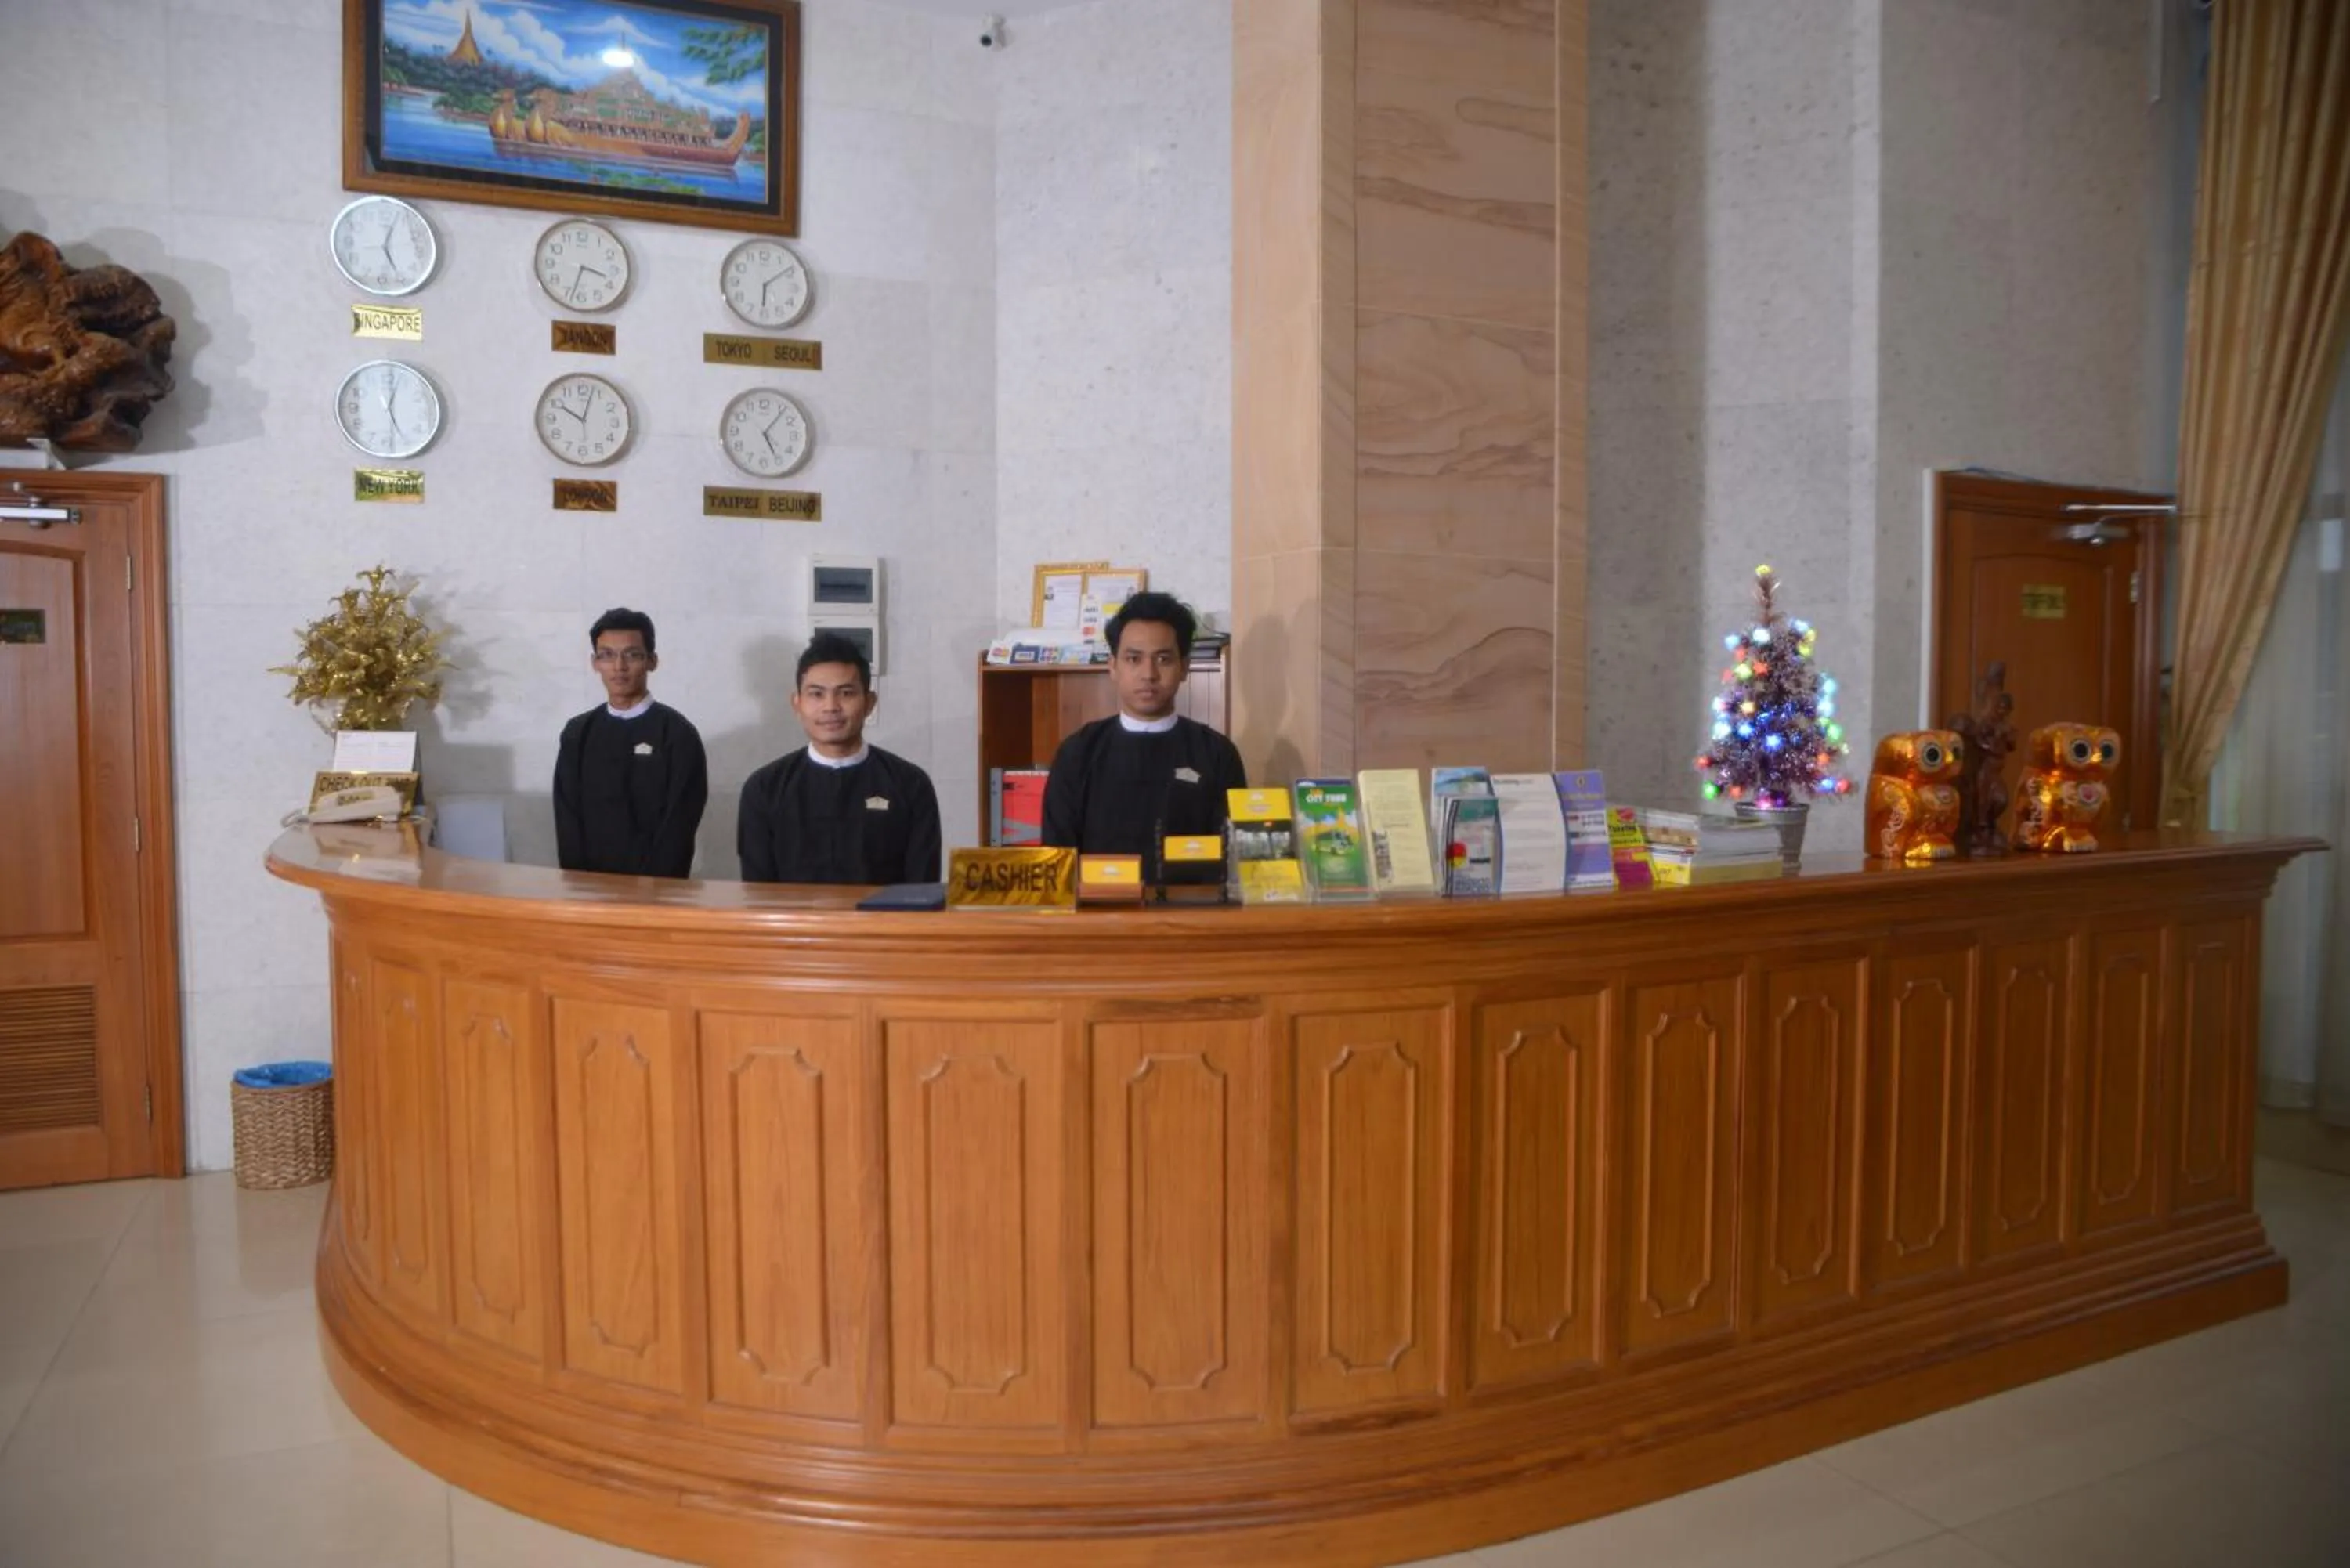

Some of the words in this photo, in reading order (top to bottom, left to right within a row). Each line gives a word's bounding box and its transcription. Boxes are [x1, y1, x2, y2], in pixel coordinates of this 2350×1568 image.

[354, 313, 421, 333] INGAPORE
[715, 340, 753, 359] TOKYO
[774, 345, 812, 363] SEOUL
[388, 478, 419, 495] YORK
[707, 495, 760, 510] TAIPEI
[768, 496, 817, 515] BEIJING
[965, 862, 1058, 891] CASHIER
